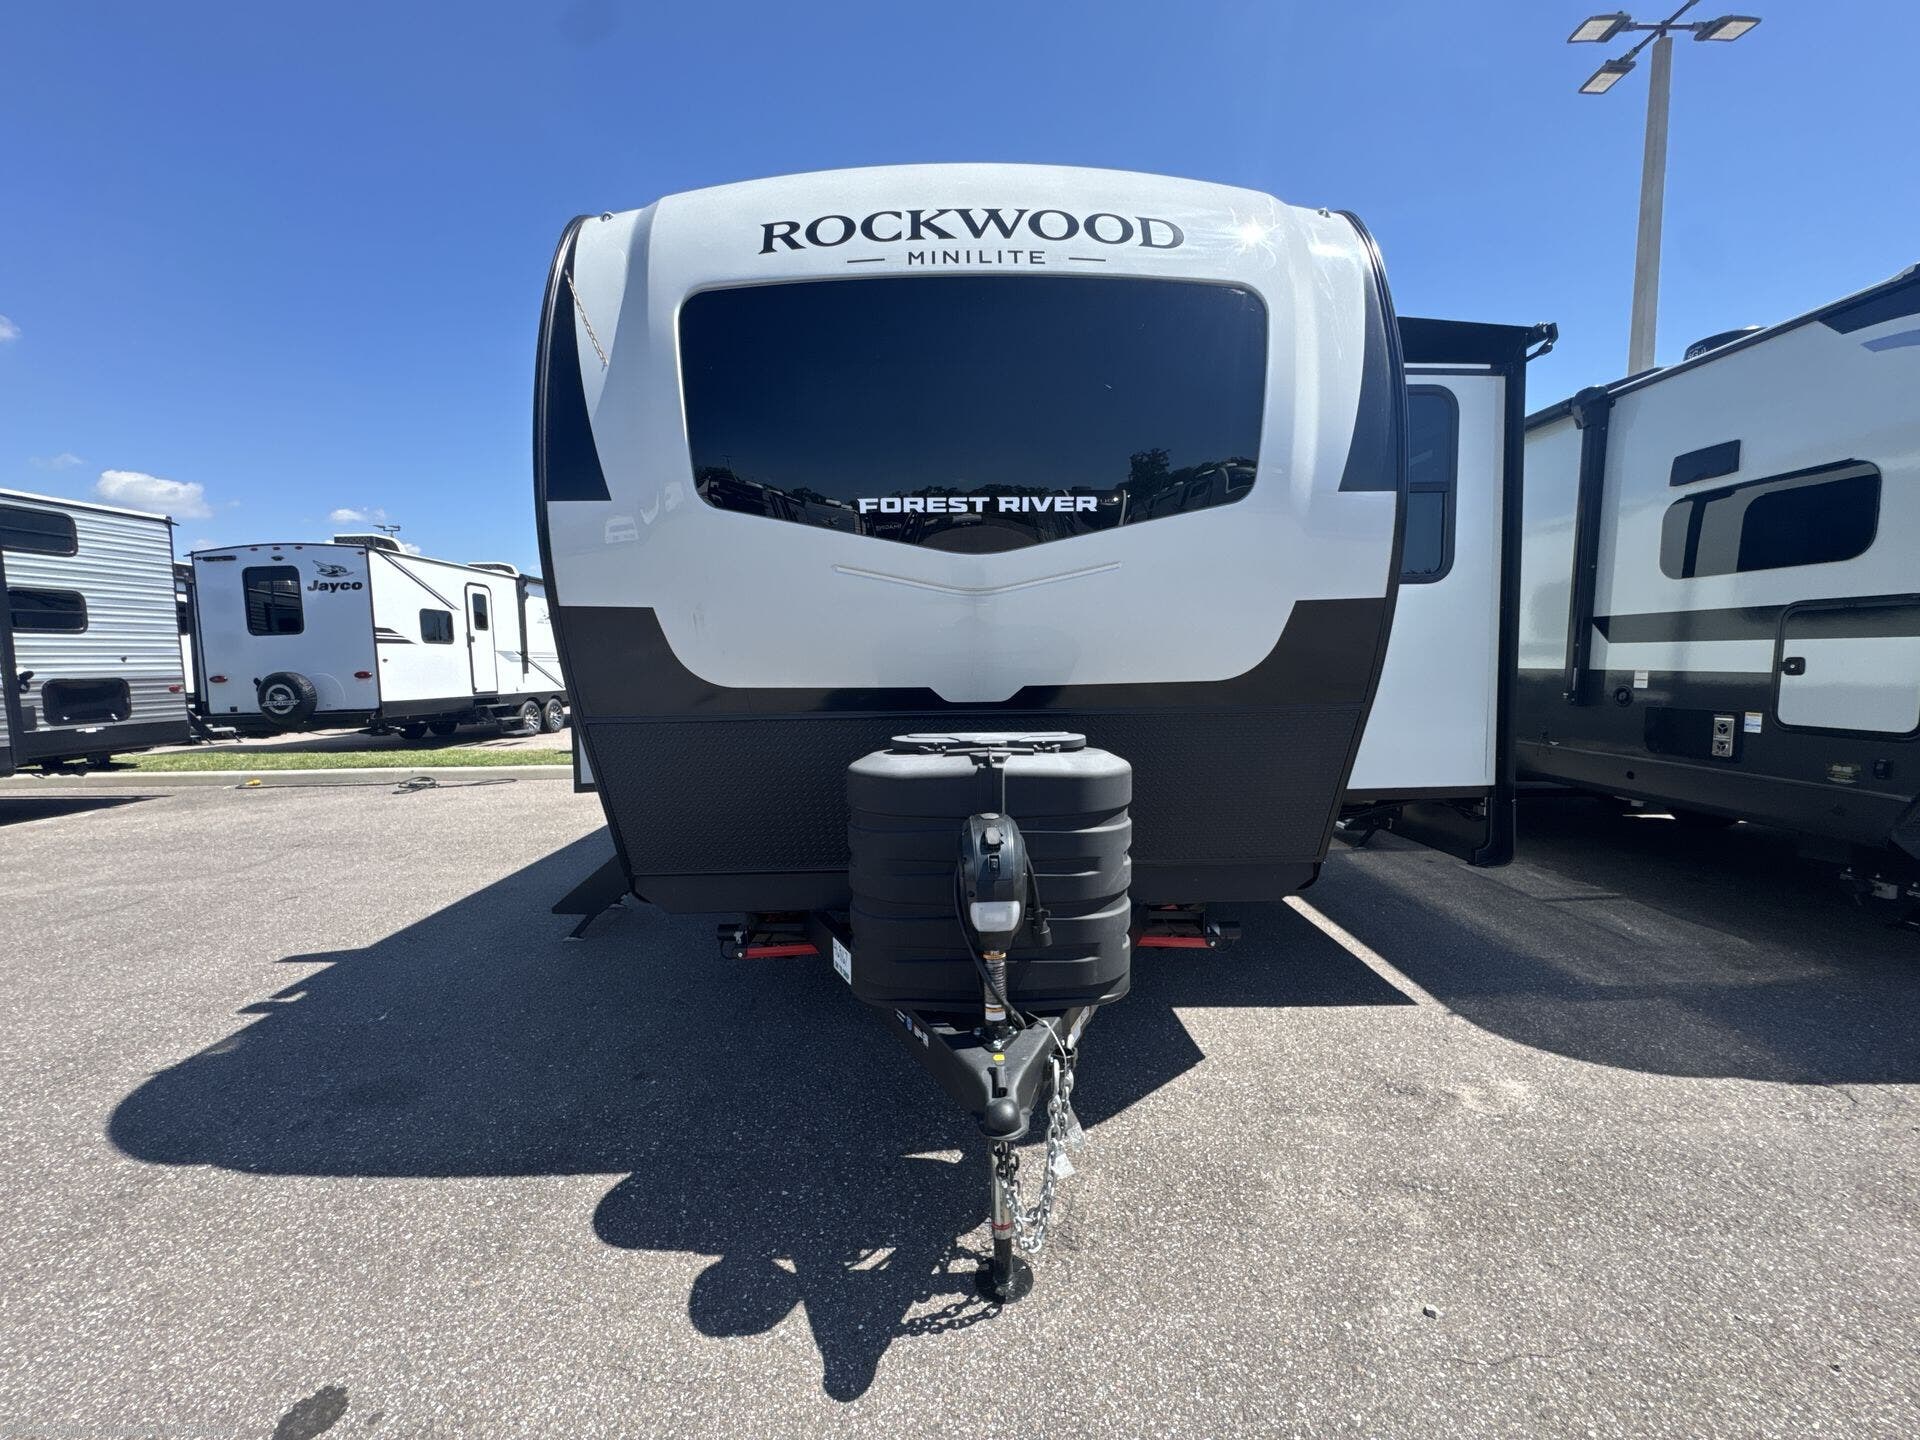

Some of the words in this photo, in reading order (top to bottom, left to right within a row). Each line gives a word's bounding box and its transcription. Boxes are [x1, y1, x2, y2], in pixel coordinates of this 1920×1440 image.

[758, 208, 1185, 254] ROCKWOOD
[908, 250, 1046, 265] MINILITE
[858, 496, 990, 514] FOREST
[997, 496, 1098, 512] RIVER
[307, 580, 363, 593] Jayco
